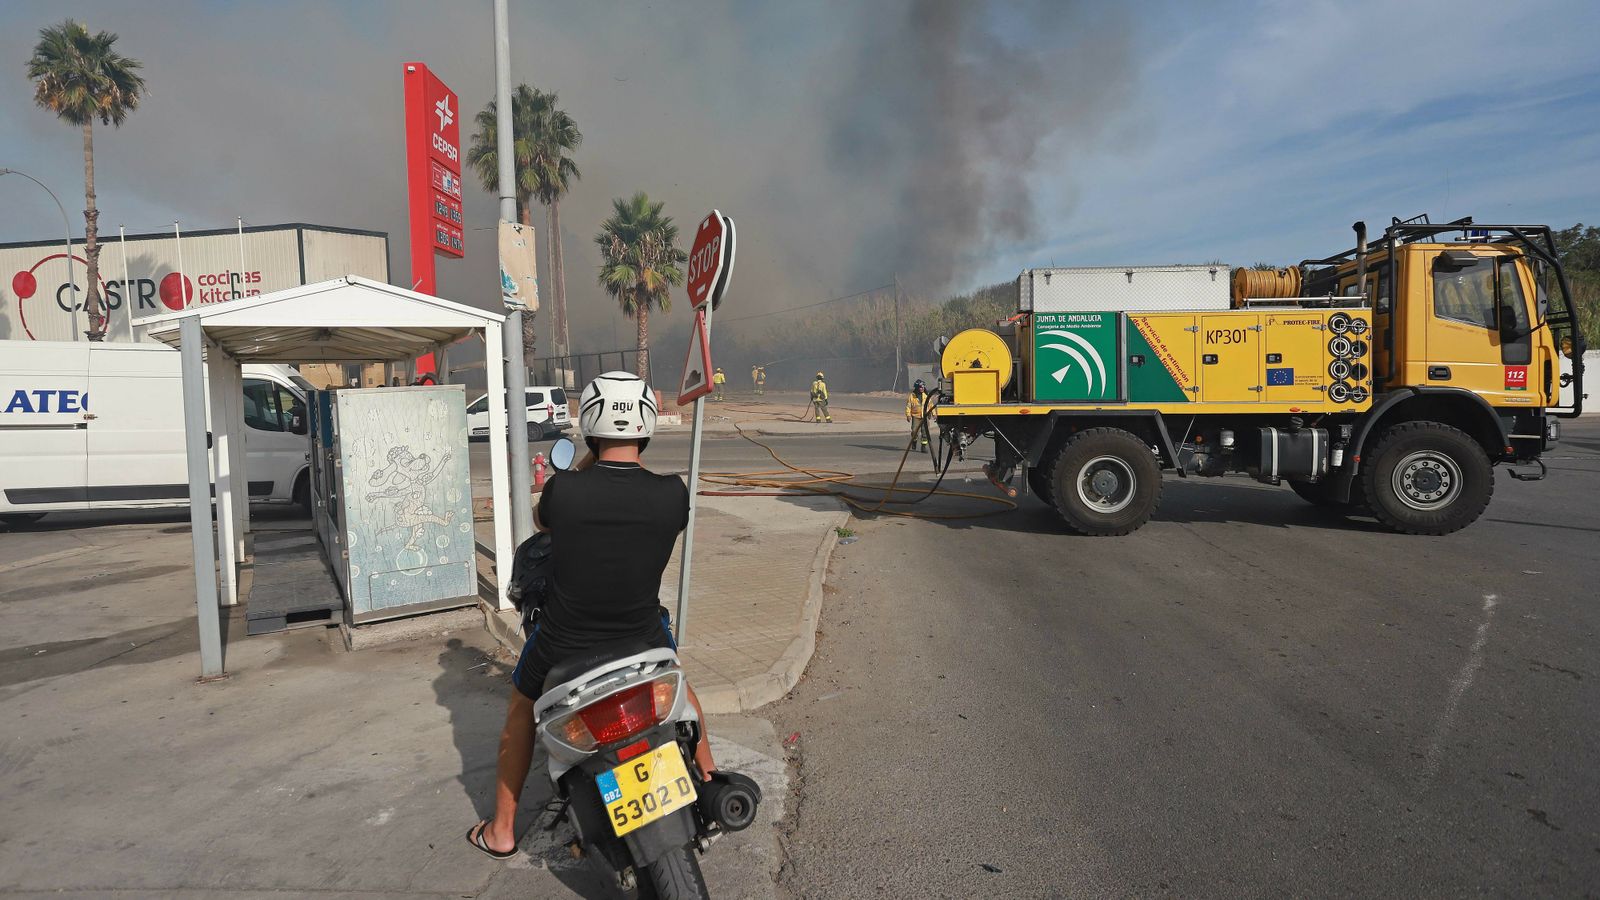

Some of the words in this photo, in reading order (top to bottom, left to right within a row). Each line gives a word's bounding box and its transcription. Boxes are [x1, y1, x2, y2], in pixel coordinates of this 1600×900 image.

[432, 132, 458, 163] CEPSA
[689, 235, 720, 284] STOP
[197, 269, 262, 286] cocinas
[1036, 315, 1056, 323] JUNTA
[1206, 329, 1247, 344] KP301
[1133, 318, 1140, 327] de
[1140, 327, 1162, 358] incendios
[1162, 357, 1185, 390] forestales
[1141, 316, 1161, 344] Servicio
[1160, 344, 1168, 353] de
[1167, 353, 1189, 383] extinción
[1507, 370, 1525, 379] 112
[0, 390, 88, 413] ATE
[612, 401, 634, 413] agv
[634, 762, 649, 783] G
[603, 788, 622, 802] GBZ
[613, 786, 672, 827] 5302
[675, 776, 691, 797] D
